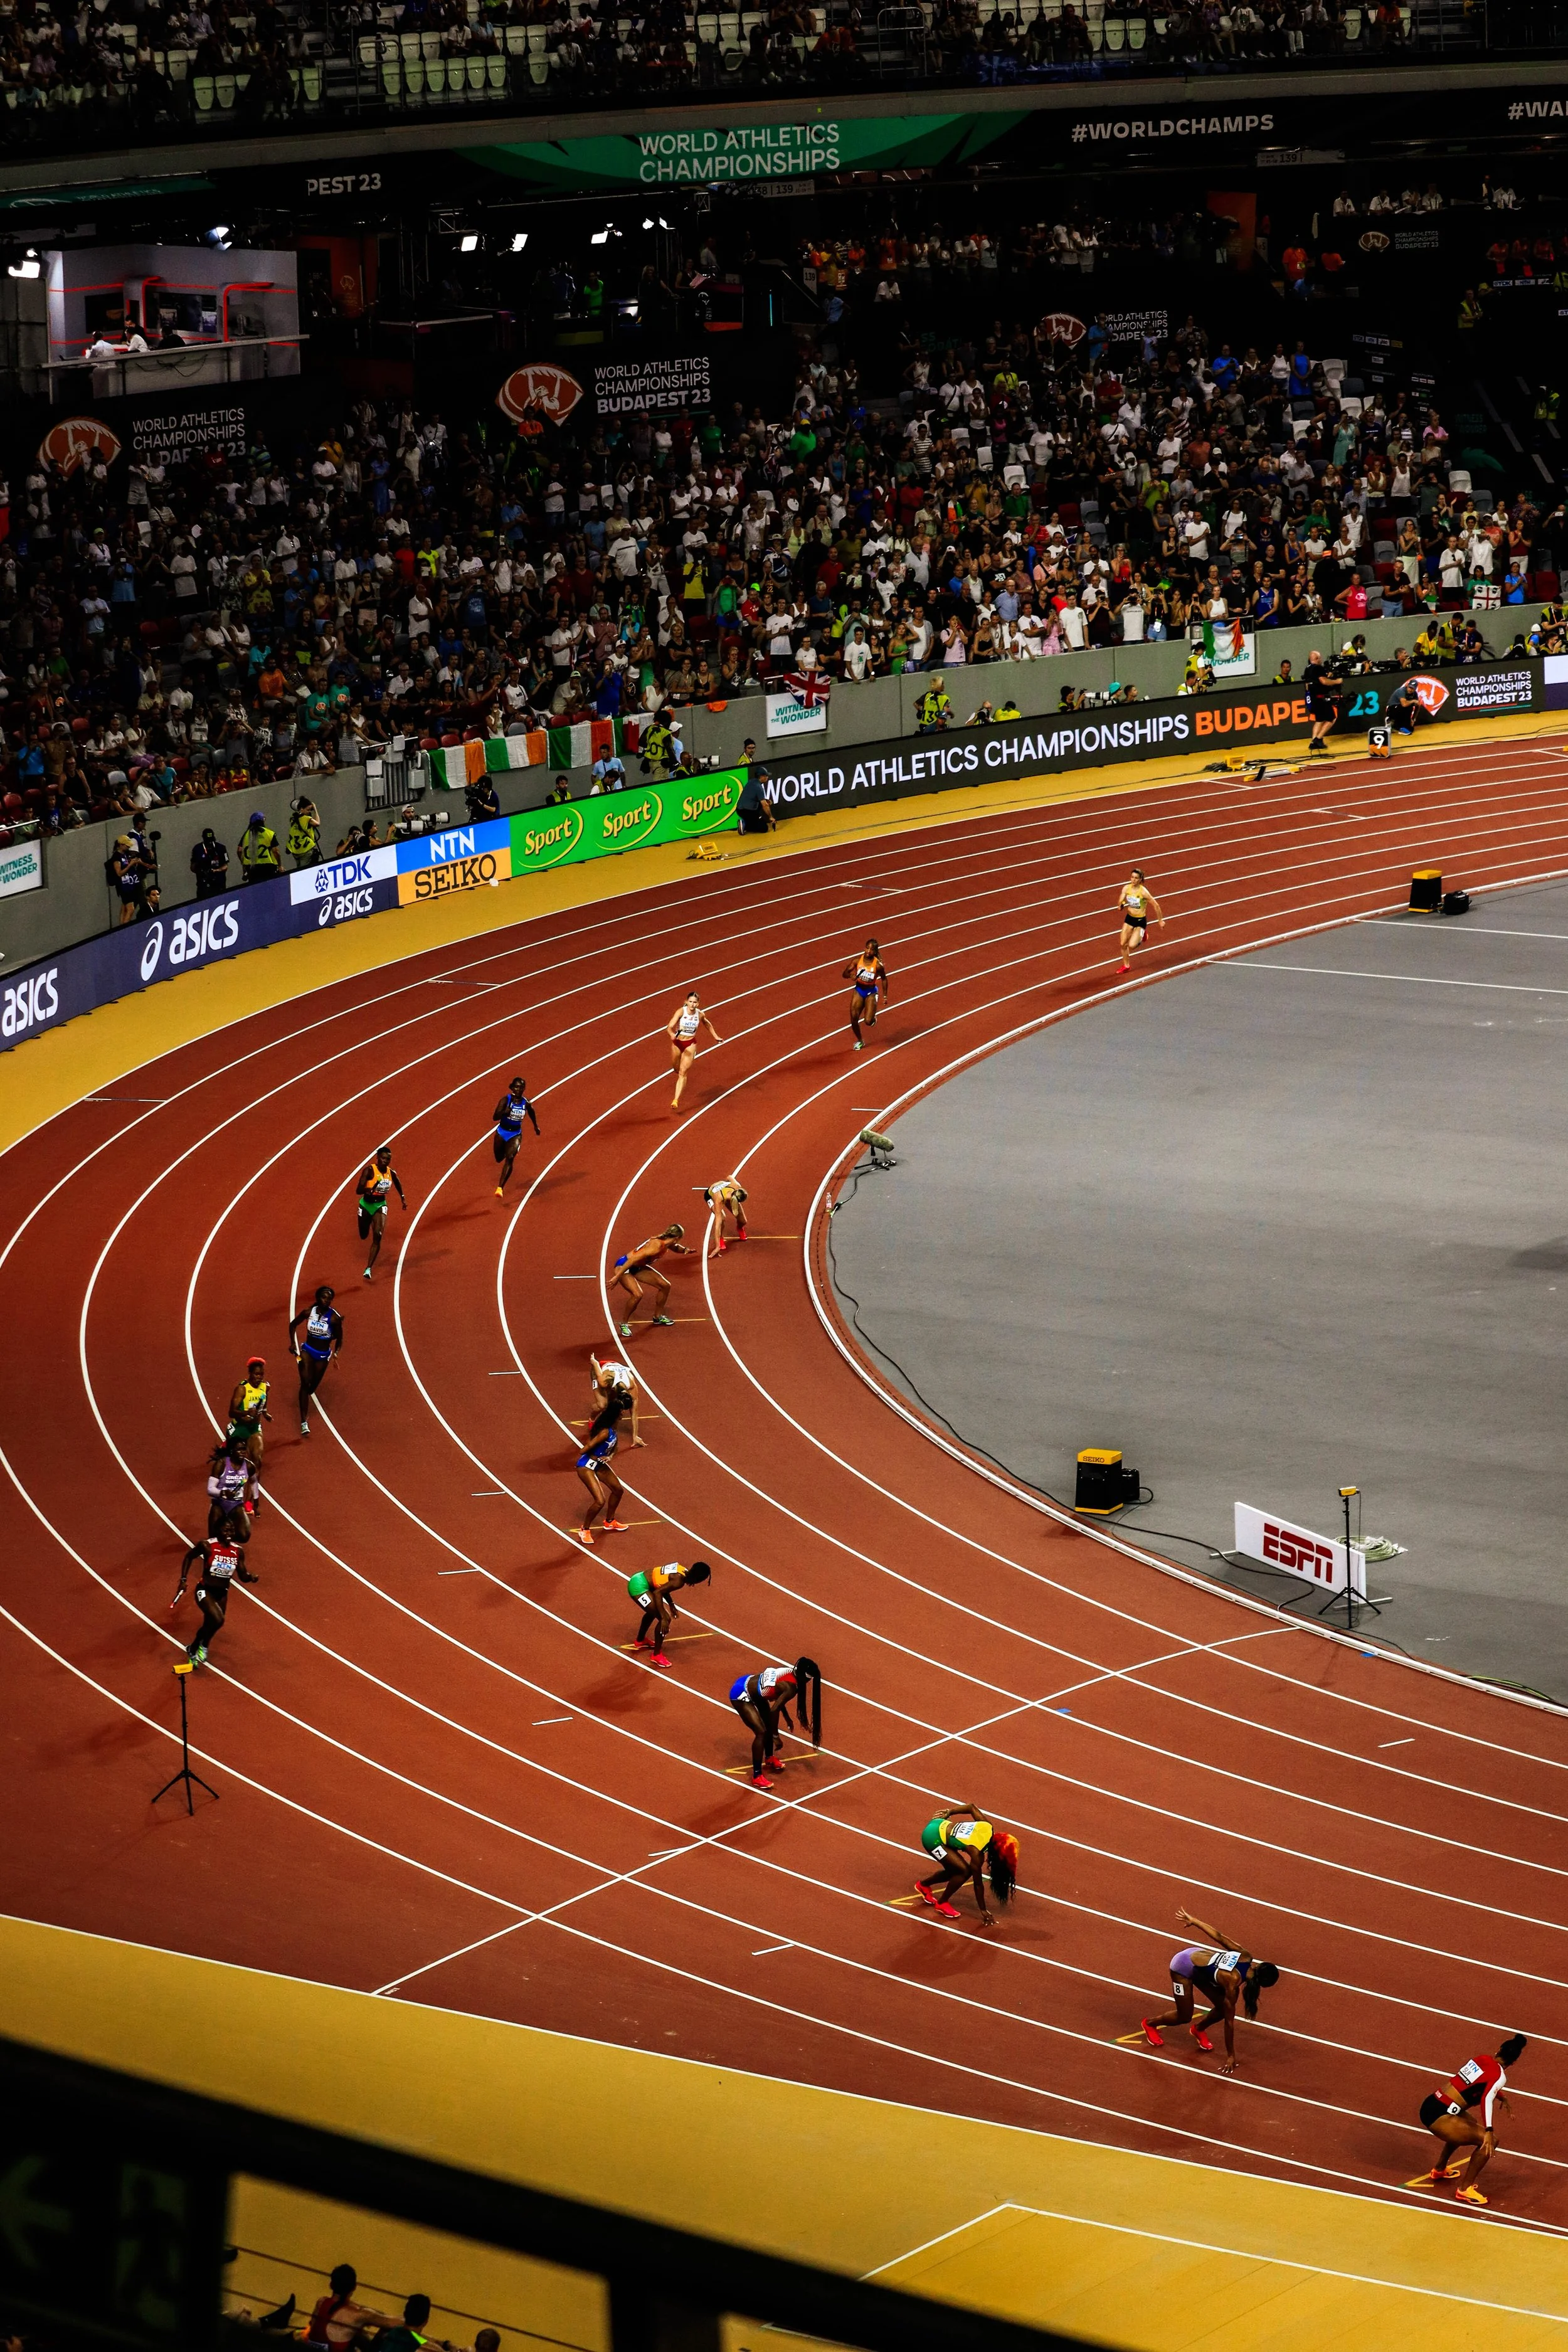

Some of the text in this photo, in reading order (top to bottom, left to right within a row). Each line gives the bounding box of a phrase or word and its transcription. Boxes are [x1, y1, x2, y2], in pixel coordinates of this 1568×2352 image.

[1071, 114, 1274, 142] #WORLDCHAMPS
[639, 124, 839, 156] WORLD ATHLETICS
[640, 148, 840, 183] CHAMPIONSHIPS
[305, 173, 381, 196] PEST 23
[776, 184, 793, 194] 139
[805, 272, 815, 280] 139
[1125, 310, 1168, 320] ATHLETICS
[1156, 329, 1168, 339] 23
[595, 357, 710, 379] WORLD ATHLETICS
[595, 372, 710, 395] CHAMPIONSHIPS
[597, 388, 711, 414] BUDAPEST 23
[132, 408, 245, 433] WORLD ATHLETICS
[133, 423, 245, 450] CHAMPIONSHIPS
[227, 440, 246, 457] 23
[1456, 671, 1532, 686] WORLD ATHLETICS
[1456, 681, 1532, 696] CHAMPIONSHIPS
[1457, 691, 1532, 707] BUDAPEST 23
[775, 704, 805, 717] WITNE
[780, 707, 822, 725] WONDER
[764, 691, 1380, 804] WORLD ATHLETICS CHAMPIONSHIPS BUDAPE 23
[1374, 735, 1385, 750] 9
[682, 784, 733, 820] Sport
[603, 800, 652, 839] Sport
[430, 827, 475, 863] NTN
[524, 817, 574, 856] Sport
[3, 862, 38, 884] WONDER
[327, 856, 373, 889] TDK
[415, 854, 497, 899] SEIKO
[309, 1326, 324, 1334] DAVIS
[214, 1554, 238, 1565] SUISSE
[1263, 1523, 1333, 1584] ESPN
[965, 1824, 975, 1835] NTN
[935, 1849, 941, 1857] 7
[1227, 1955, 1238, 1968] NTN
[1175, 1985, 1181, 1993] 8
[1462, 2067, 1471, 2076] SUI
